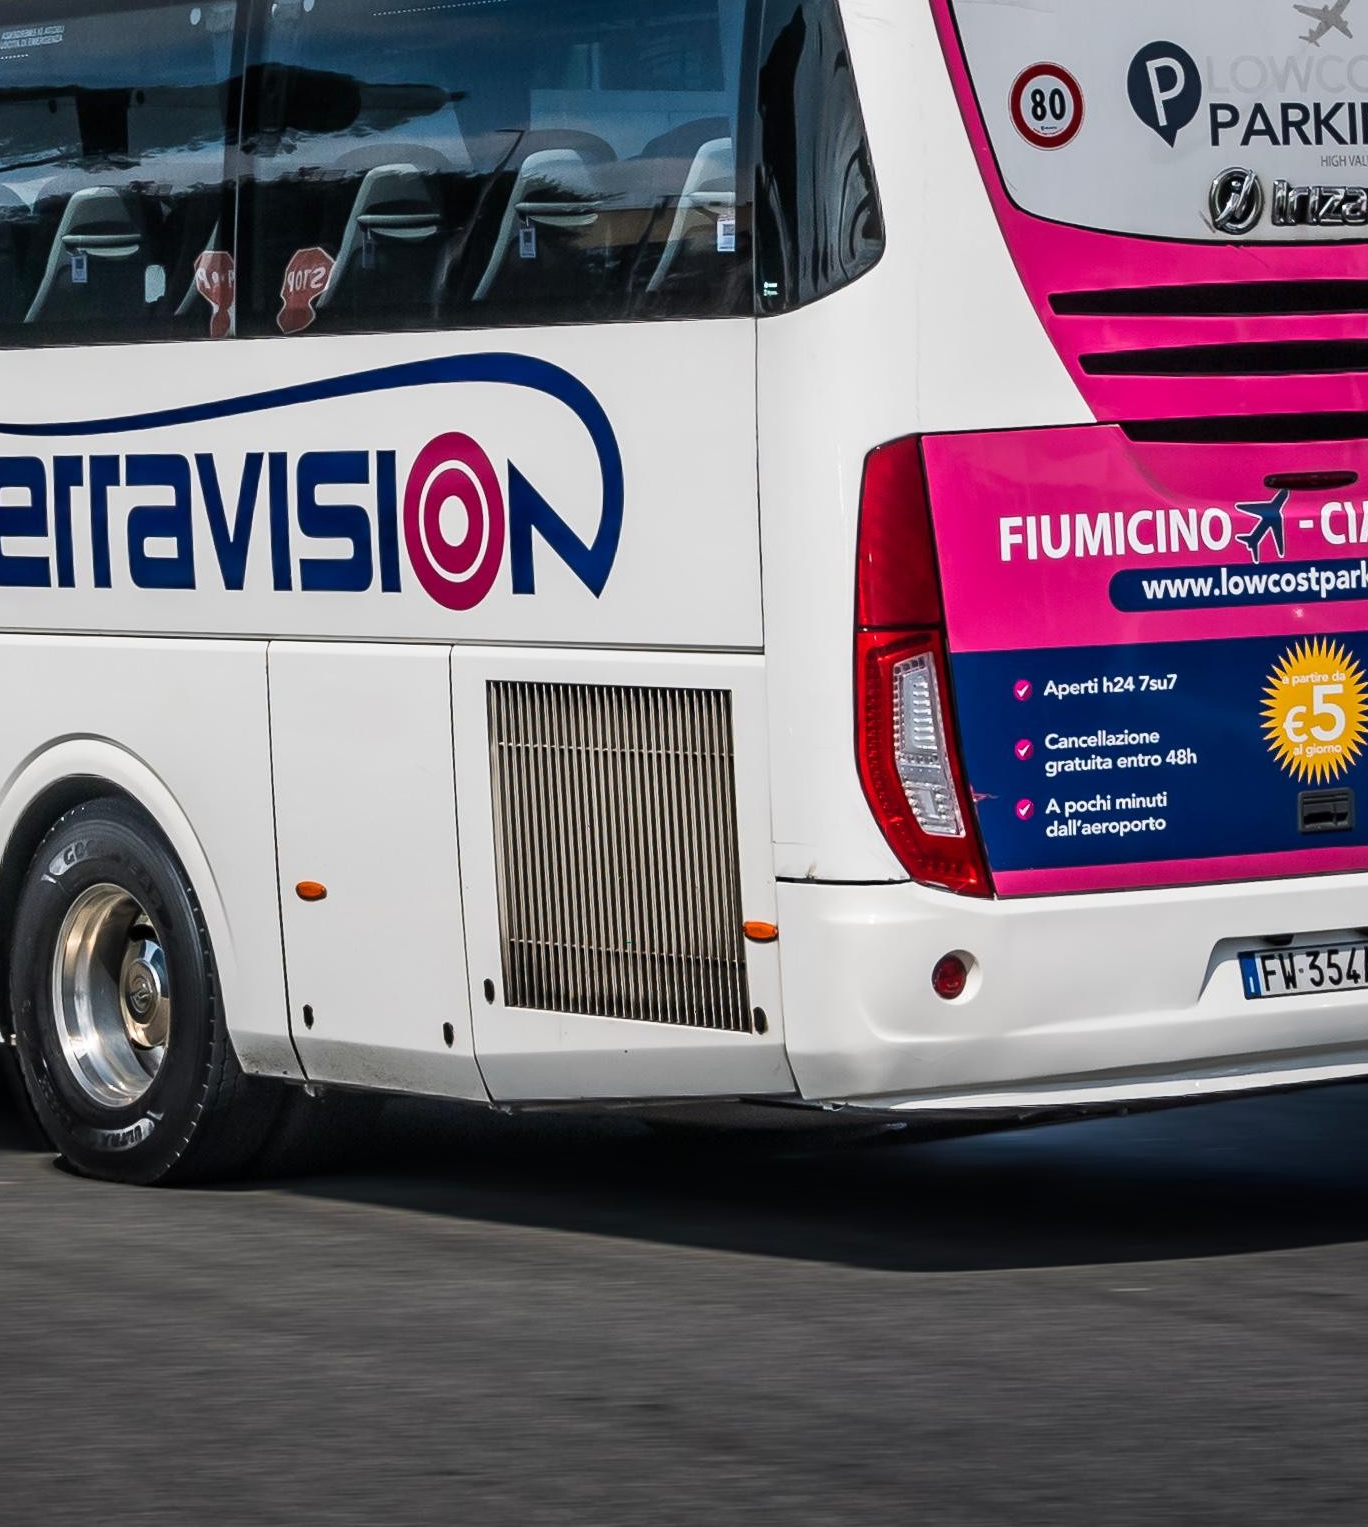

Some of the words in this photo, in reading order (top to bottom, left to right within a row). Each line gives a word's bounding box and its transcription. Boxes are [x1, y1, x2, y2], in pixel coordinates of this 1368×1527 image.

[1030, 87, 1067, 122] 80
[1320, 155, 1349, 167] HIGH
[998, 506, 1233, 563] FIUMICINO
[1043, 677, 1099, 700] Aperti
[1102, 675, 1136, 694] h24
[1139, 673, 1178, 692] 7su7
[1291, 671, 1329, 687] partire
[1331, 669, 1347, 682] da
[1044, 729, 1161, 750] Cancellazione
[1305, 743, 1343, 758] giorno
[1044, 754, 1113, 778] gratuita
[1116, 752, 1163, 769] entro
[1165, 747, 1198, 766] 48h
[1044, 797, 1061, 815] A
[1064, 793, 1112, 818] pochi
[1115, 791, 1168, 810] minuti
